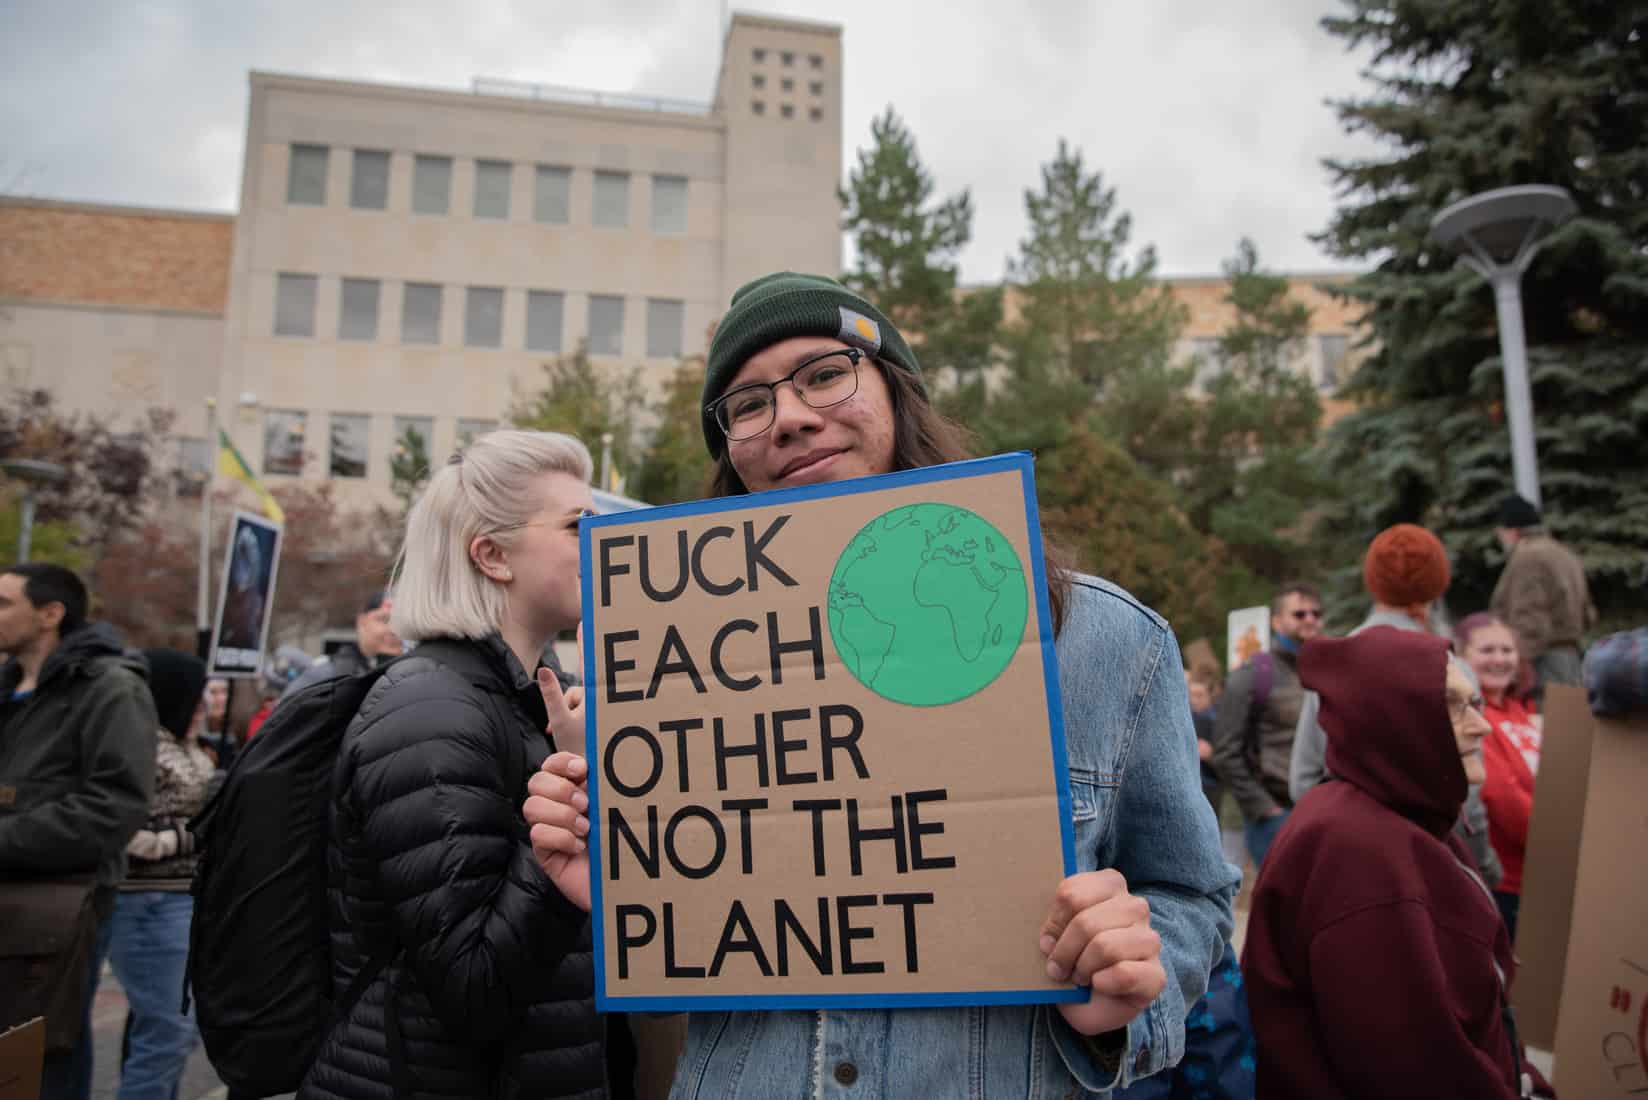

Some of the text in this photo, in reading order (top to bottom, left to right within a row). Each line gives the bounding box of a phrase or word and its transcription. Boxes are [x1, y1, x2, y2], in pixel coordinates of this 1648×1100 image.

[599, 515, 799, 607] FUCK
[603, 606, 826, 704] EACH
[603, 704, 871, 798] OTHER
[608, 789, 956, 881] NOT THE
[615, 892, 935, 980] PLANET
